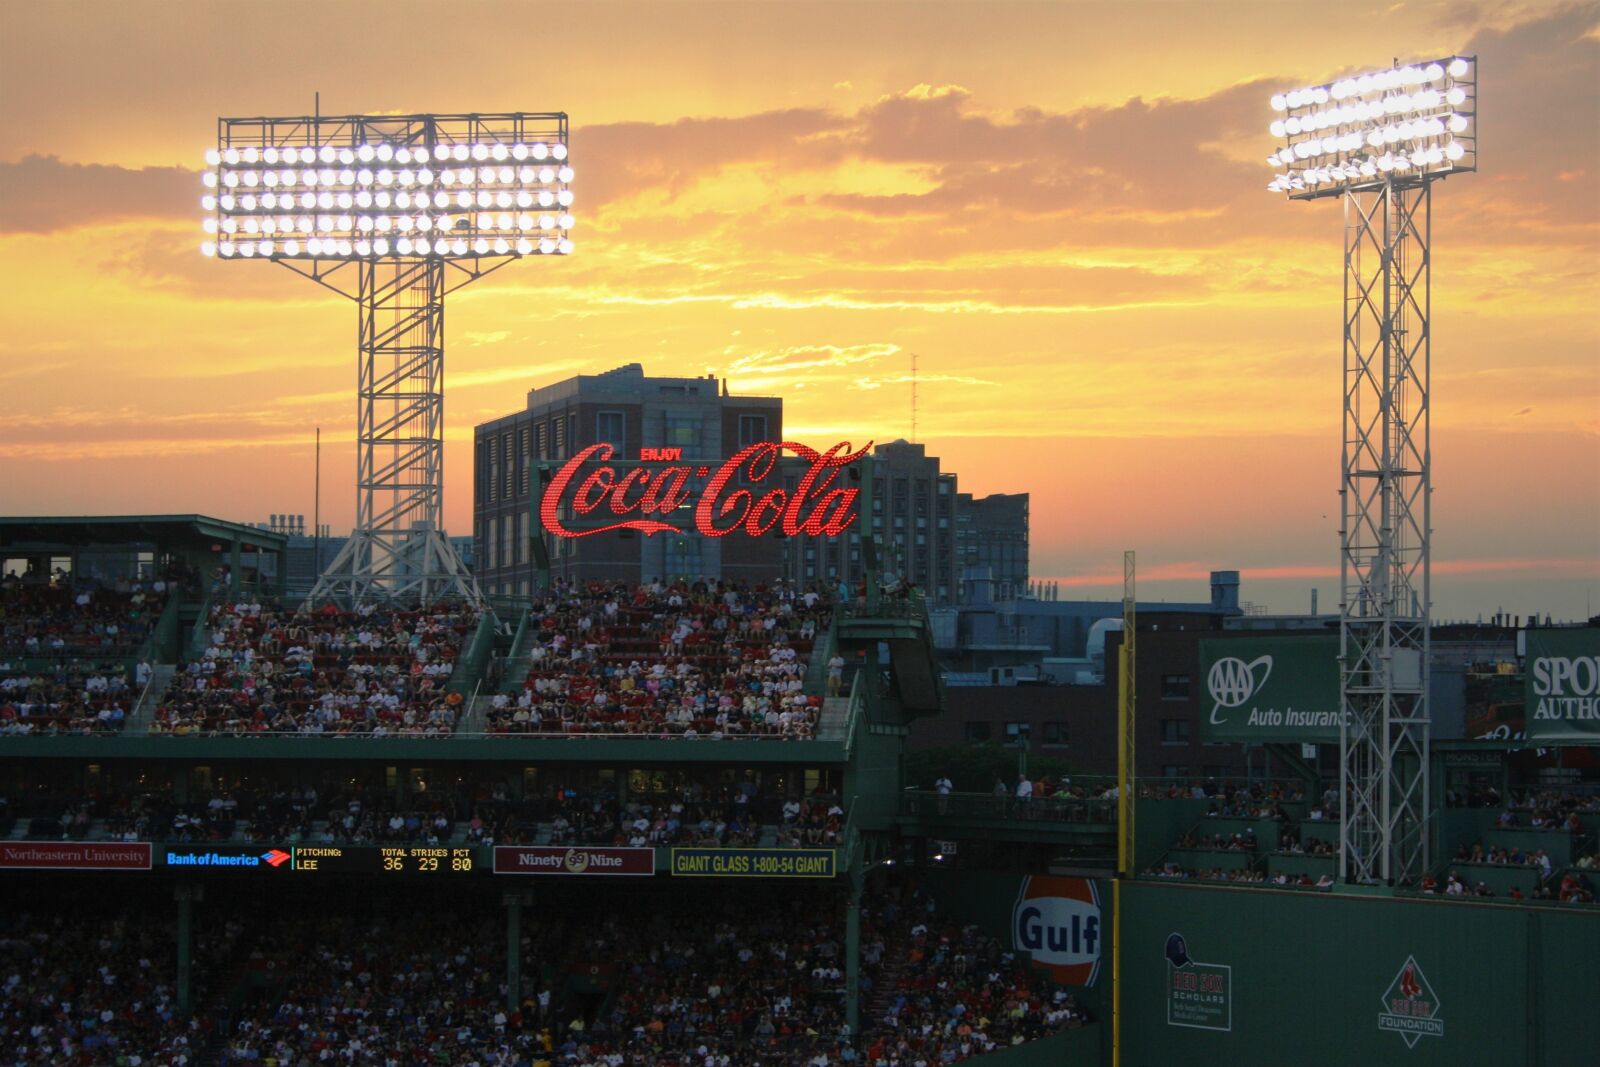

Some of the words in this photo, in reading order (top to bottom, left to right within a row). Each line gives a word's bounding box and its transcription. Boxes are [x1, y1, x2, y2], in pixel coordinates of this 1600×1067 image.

[640, 448, 683, 461] ENJOY
[540, 440, 874, 538] Coca-Cola
[1212, 659, 1250, 704] AAA
[1533, 656, 1600, 696] SPO
[1248, 707, 1282, 726] Auto
[1446, 752, 1502, 762] MONSTER
[5, 849, 81, 861] Northeastern
[84, 850, 145, 864] University
[167, 853, 200, 865] Bank
[201, 853, 211, 865] of
[212, 853, 259, 866] America
[296, 849, 342, 857] PITCHING:
[381, 849, 407, 857] TOTAL
[410, 849, 448, 857] STRIKES
[453, 849, 470, 857] PCT
[518, 853, 563, 868] Ninety
[569, 853, 585, 866] 99
[590, 855, 623, 867] Nine
[296, 860, 318, 870] LEE
[383, 858, 403, 871] 36
[418, 858, 438, 871] 29
[452, 859, 472, 871] 80
[677, 855, 710, 872] GIANT
[712, 855, 750, 872] GLASS
[752, 856, 793, 873] 1-800-54
[795, 857, 828, 873] GIANT
[1019, 906, 1099, 955] Gulf
[1173, 991, 1225, 1004] SCHOLARS
[1380, 1016, 1441, 1032] FOUNDATION
